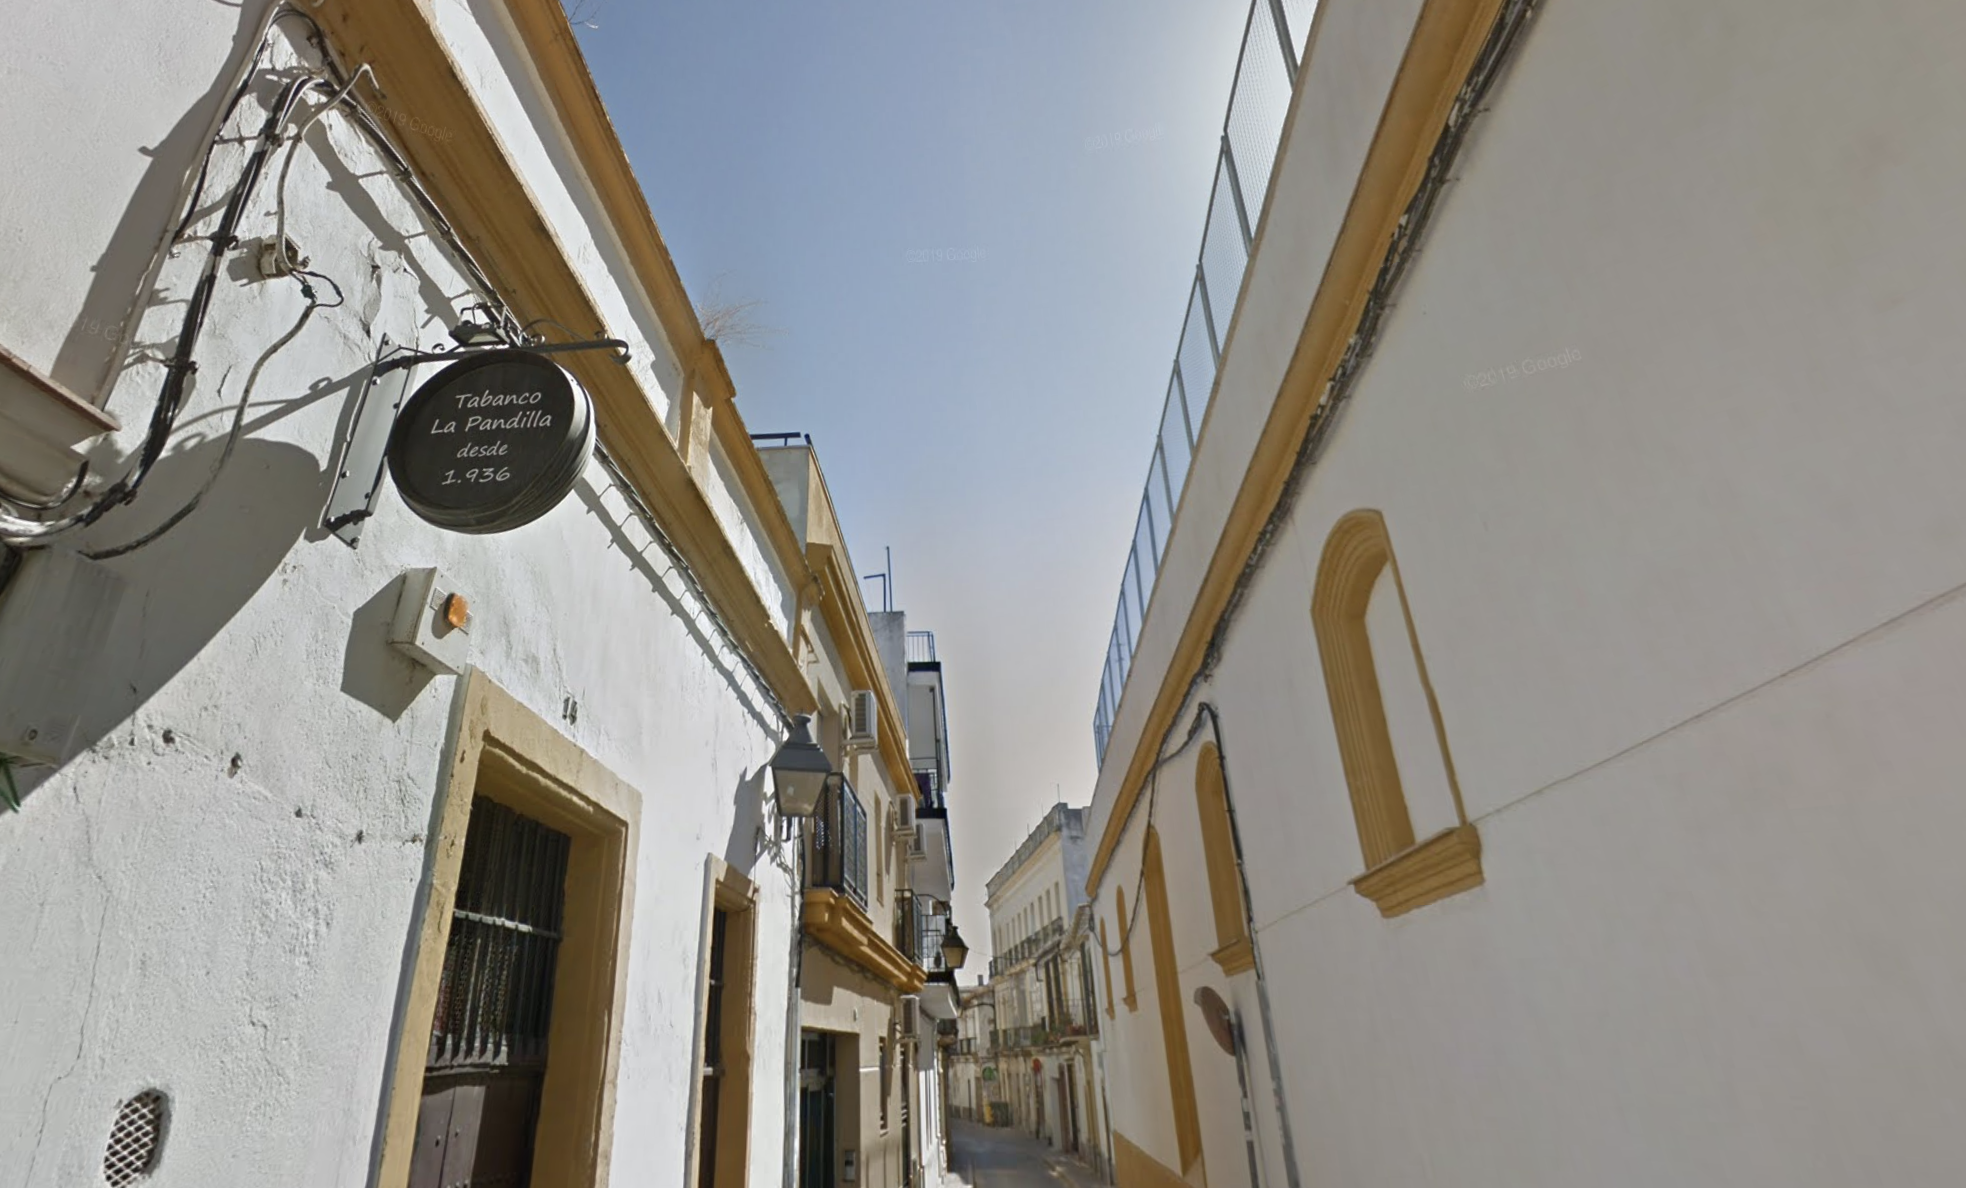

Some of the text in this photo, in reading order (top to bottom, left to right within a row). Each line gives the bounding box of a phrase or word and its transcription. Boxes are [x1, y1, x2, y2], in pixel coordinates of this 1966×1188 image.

[455, 389, 542, 410] Tabanco
[430, 409, 553, 435] La Pandilla
[456, 440, 509, 459] desde
[441, 466, 511, 486] 1.936
